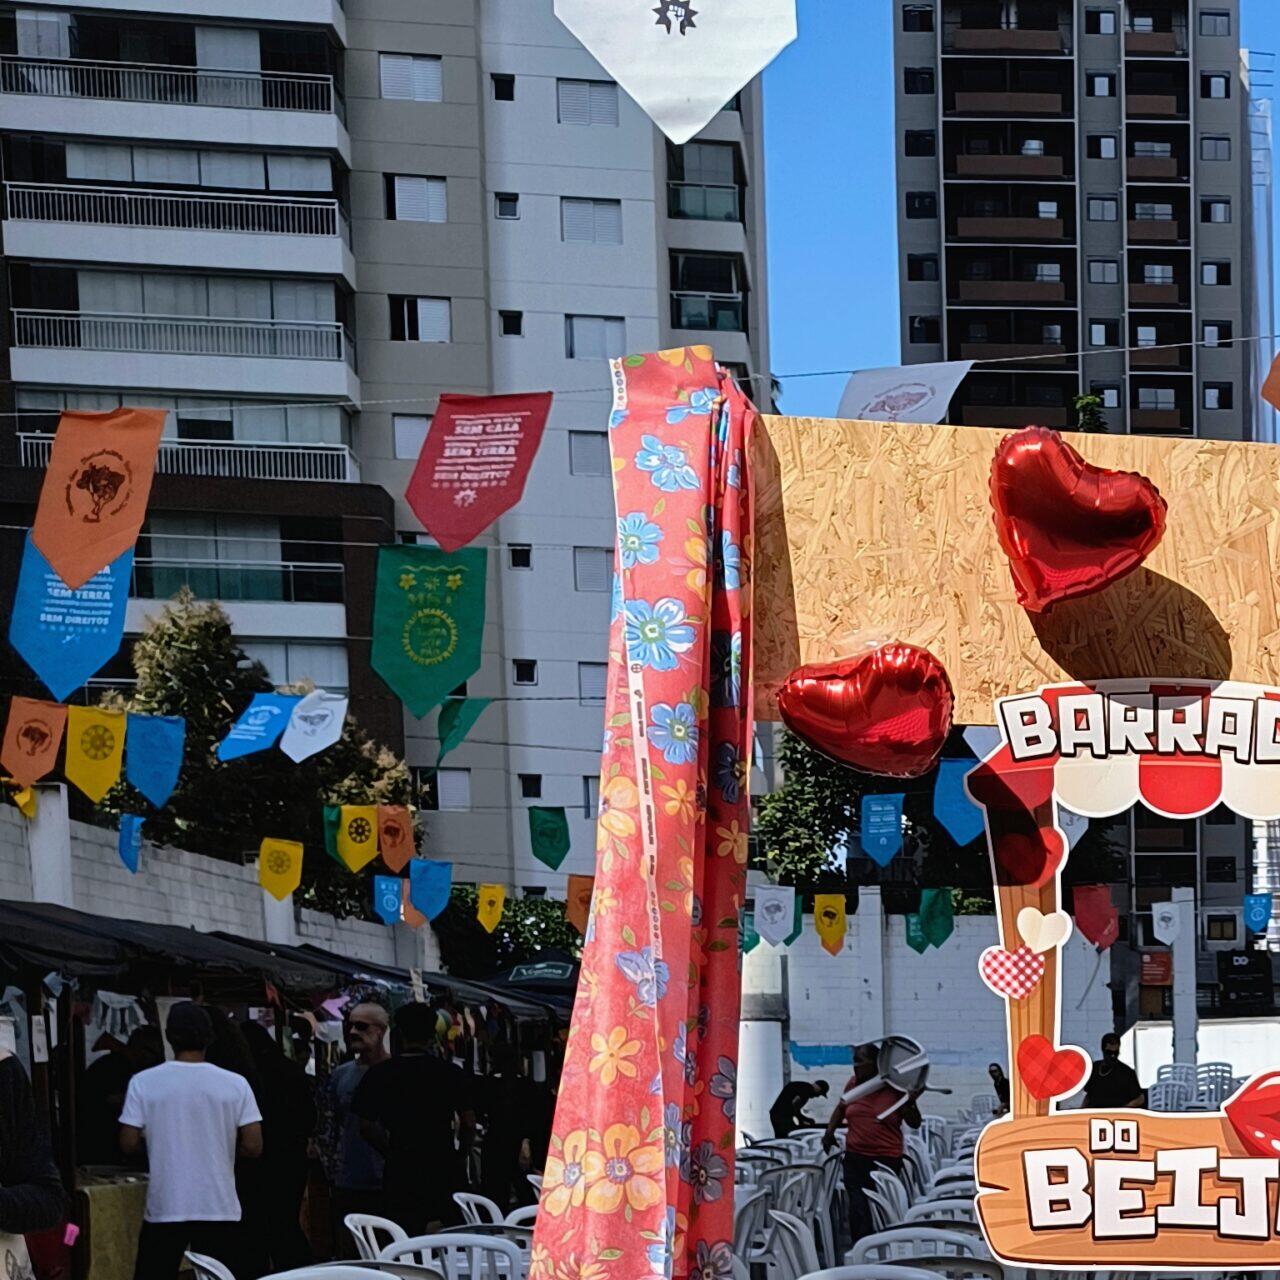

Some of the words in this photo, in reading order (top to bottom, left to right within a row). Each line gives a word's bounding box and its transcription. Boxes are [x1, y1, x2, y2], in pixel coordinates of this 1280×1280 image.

[75, 591, 110, 600] TERRA
[65, 616, 109, 625] DIREITOS
[1089, 1118, 1139, 1153] DO
